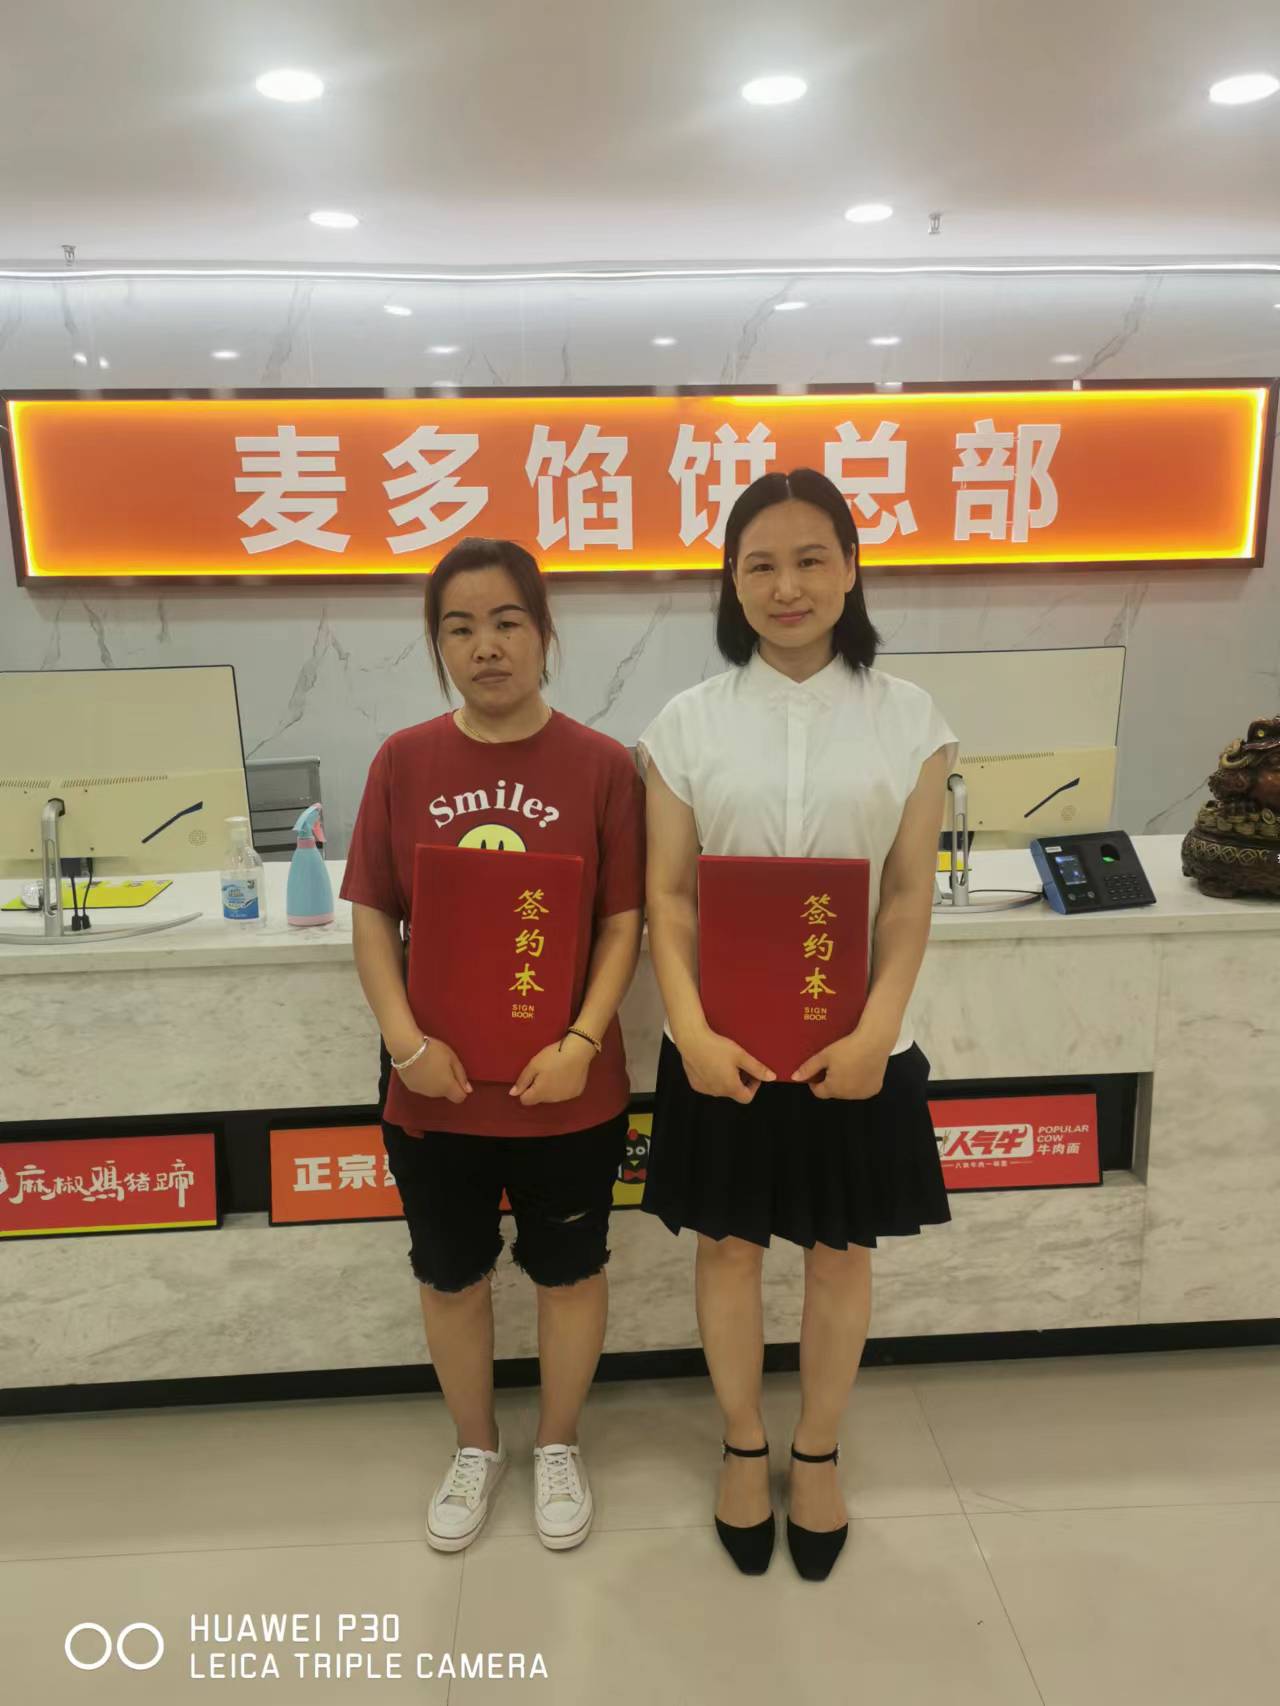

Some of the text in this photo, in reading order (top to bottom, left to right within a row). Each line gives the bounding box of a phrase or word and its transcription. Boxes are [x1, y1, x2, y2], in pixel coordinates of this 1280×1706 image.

[234, 418, 1061, 554] 麦多馅饼总部
[428, 780, 560, 829] Smile?
[508, 889, 550, 996] 签约本
[799, 893, 838, 1000] 签约本
[511, 1004, 535, 1012] SIGN
[804, 1006, 828, 1014] SIGN
[511, 1011, 534, 1019] BOOK
[803, 1013, 828, 1021] BOOK
[1038, 1125, 1089, 1134] POPULAR
[944, 1125, 1028, 1158] 人气牛
[1036, 1134, 1064, 1144] COW
[1036, 1143, 1081, 1156] 牛肉面
[293, 1153, 397, 1192] 正宗
